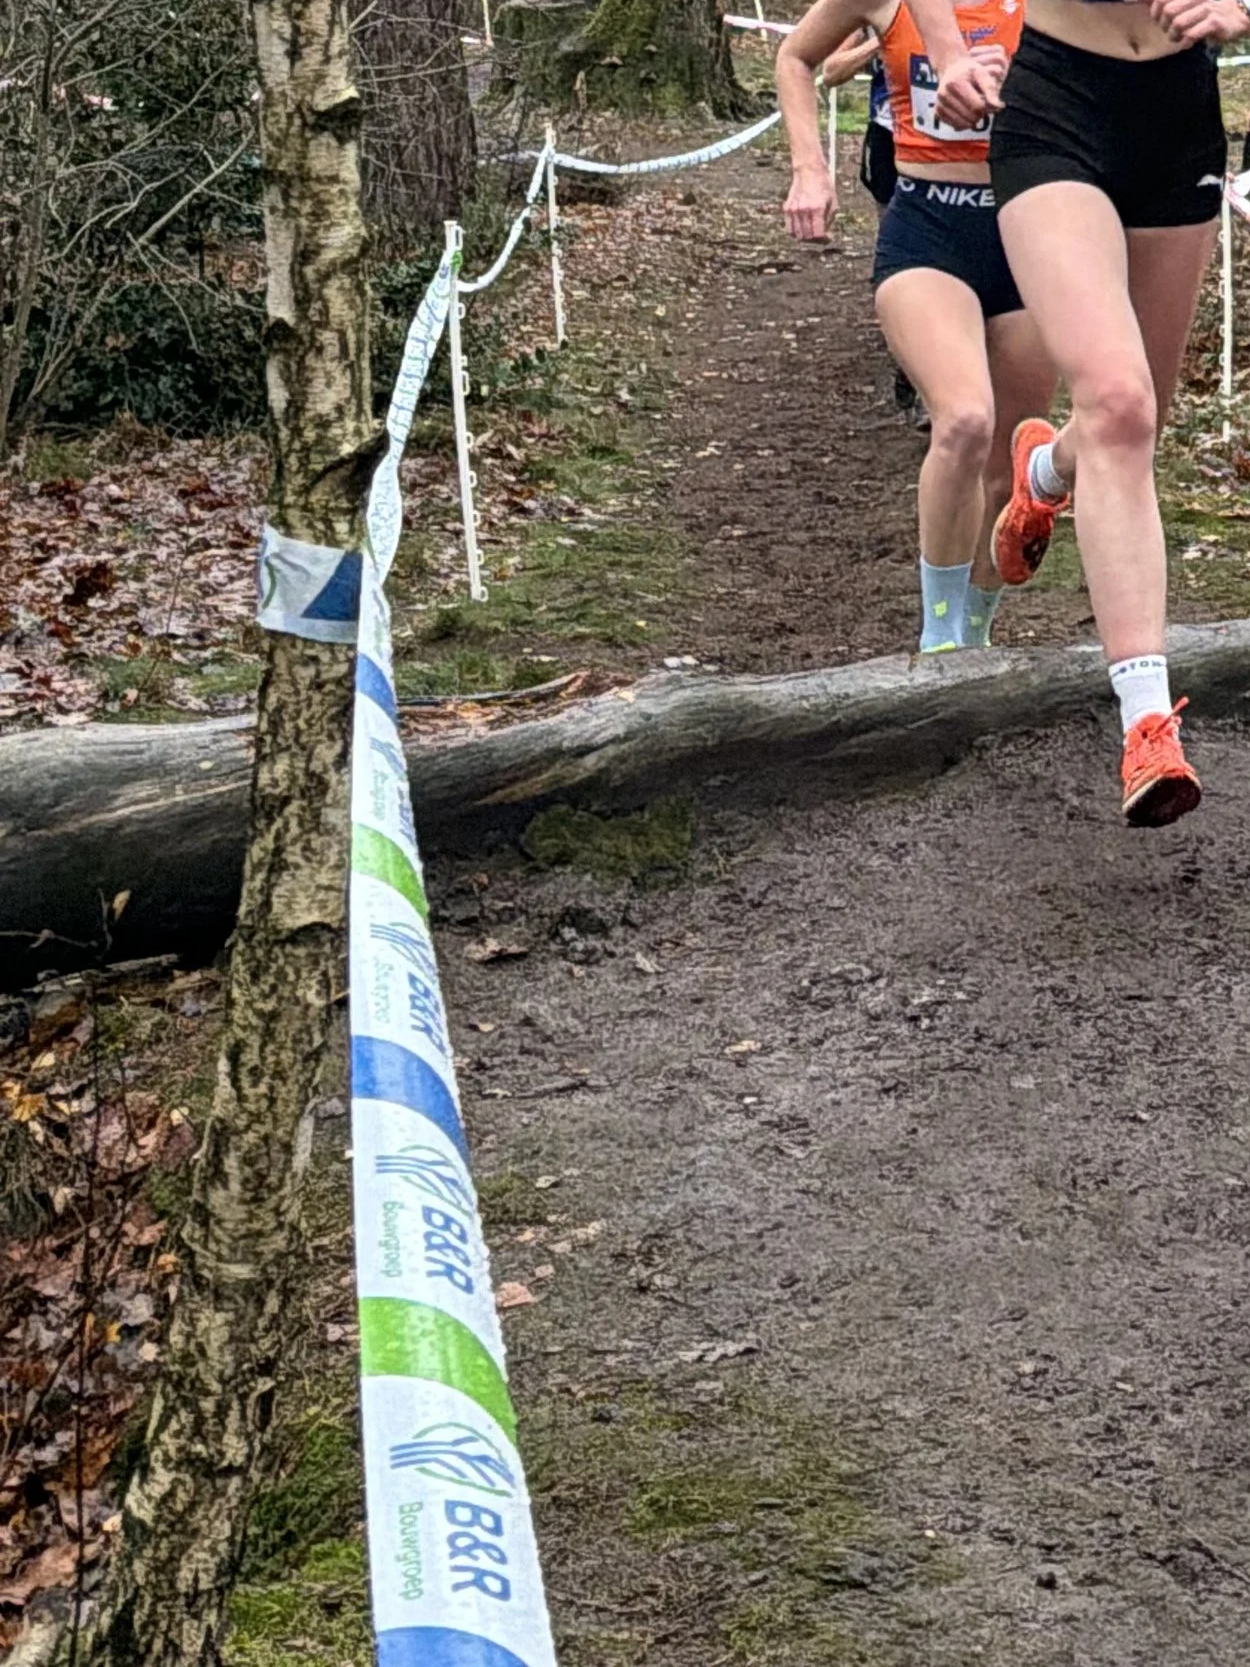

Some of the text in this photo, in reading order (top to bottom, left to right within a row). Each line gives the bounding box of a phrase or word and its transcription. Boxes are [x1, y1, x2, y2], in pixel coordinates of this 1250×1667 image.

[927, 184, 996, 208] NIKE
[422, 1204, 474, 1295] B&R
[396, 1501, 423, 1601] Bouwgroep
[445, 1499, 511, 1602] B&R
